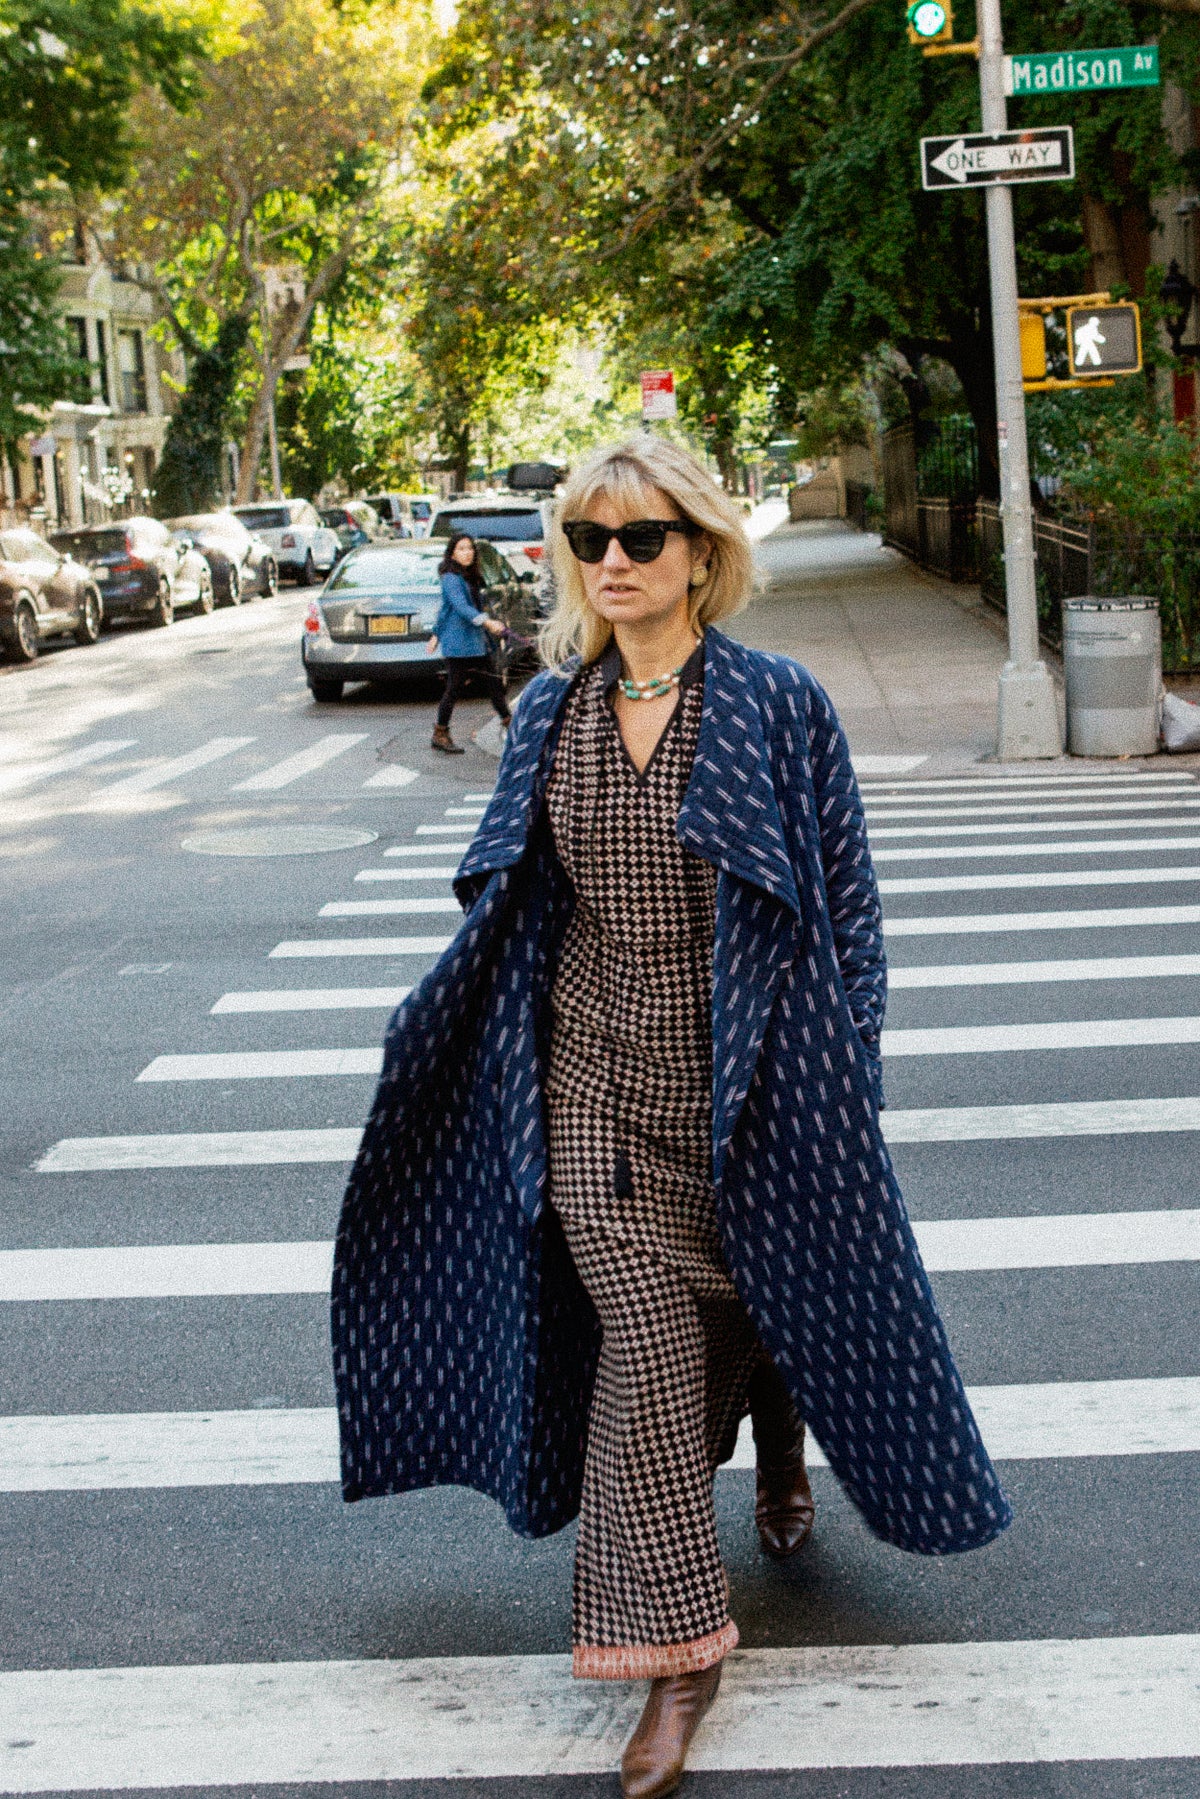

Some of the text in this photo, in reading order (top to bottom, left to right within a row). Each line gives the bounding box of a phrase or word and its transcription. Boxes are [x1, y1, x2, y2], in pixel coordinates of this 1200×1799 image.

[1014, 52, 1153, 90] Madison Av
[946, 147, 1050, 171] ONE WAY
